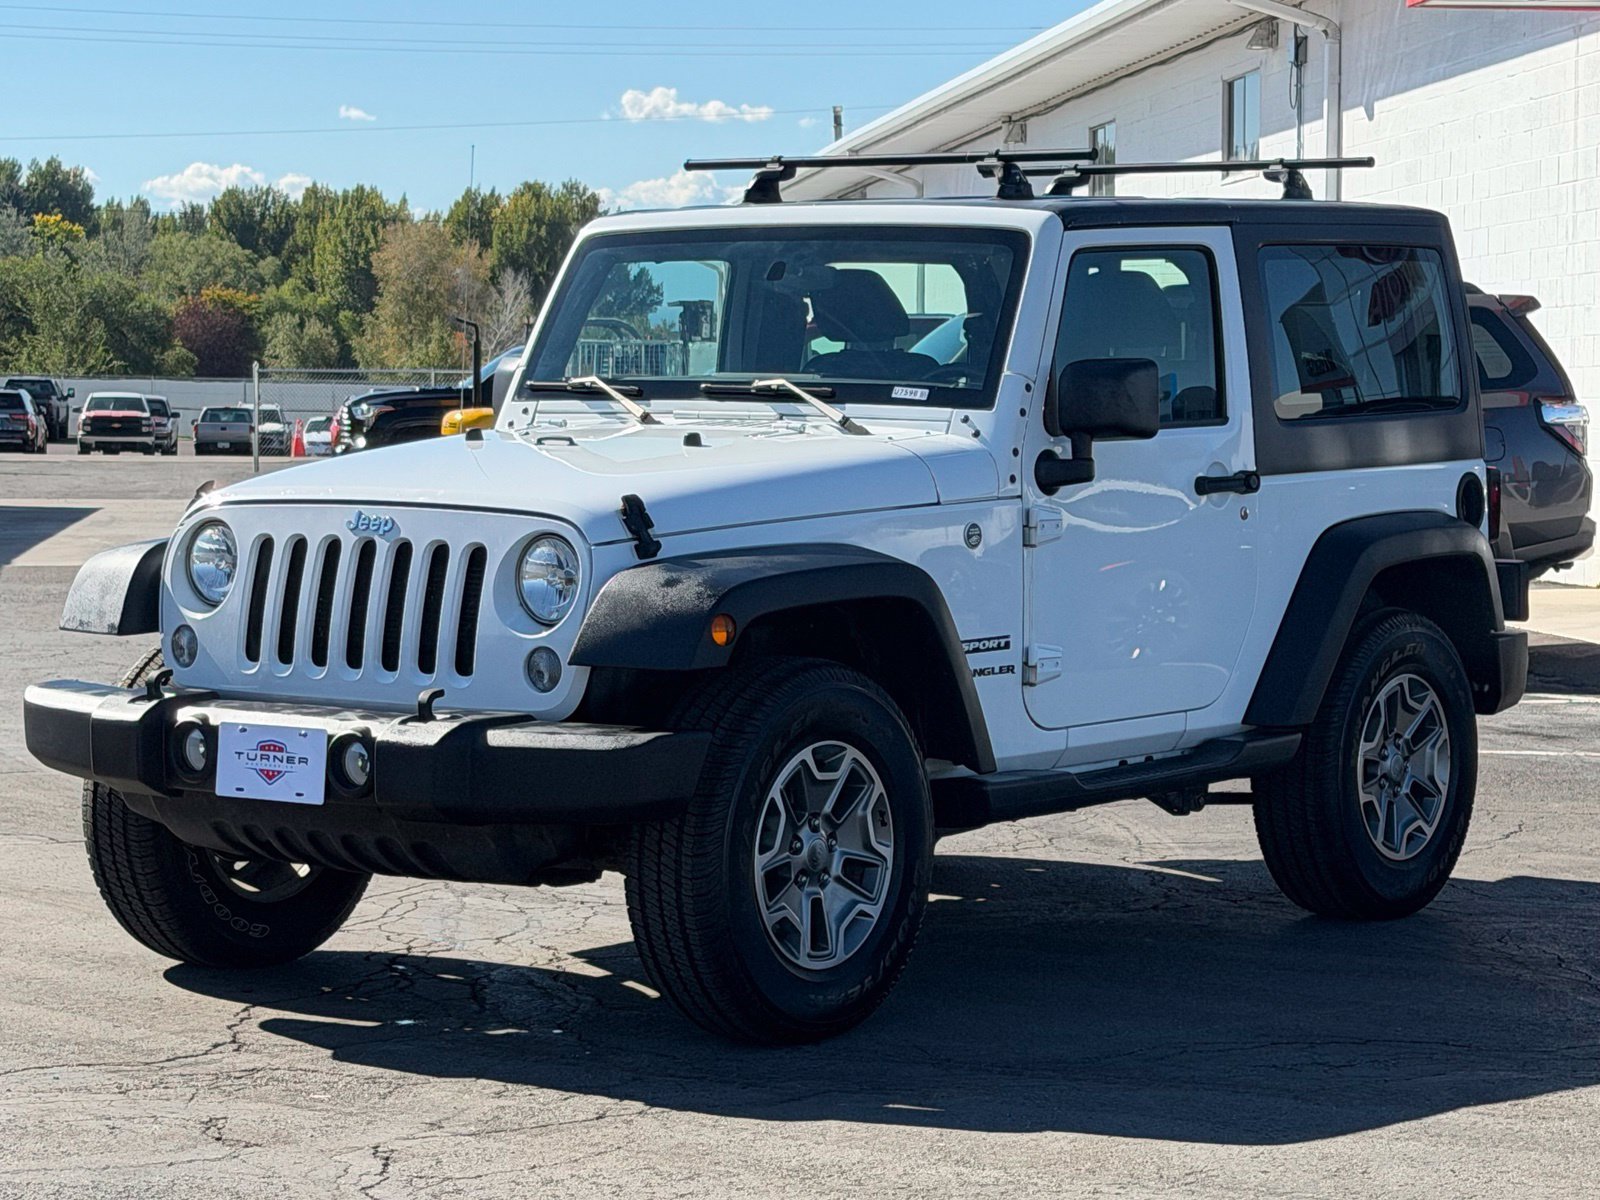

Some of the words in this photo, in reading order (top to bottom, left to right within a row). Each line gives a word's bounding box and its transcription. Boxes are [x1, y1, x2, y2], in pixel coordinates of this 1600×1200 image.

[346, 510, 394, 535] Jeep
[961, 639, 1006, 652] SPORT
[972, 664, 1016, 677] NGLER
[234, 751, 309, 766] TURNER
